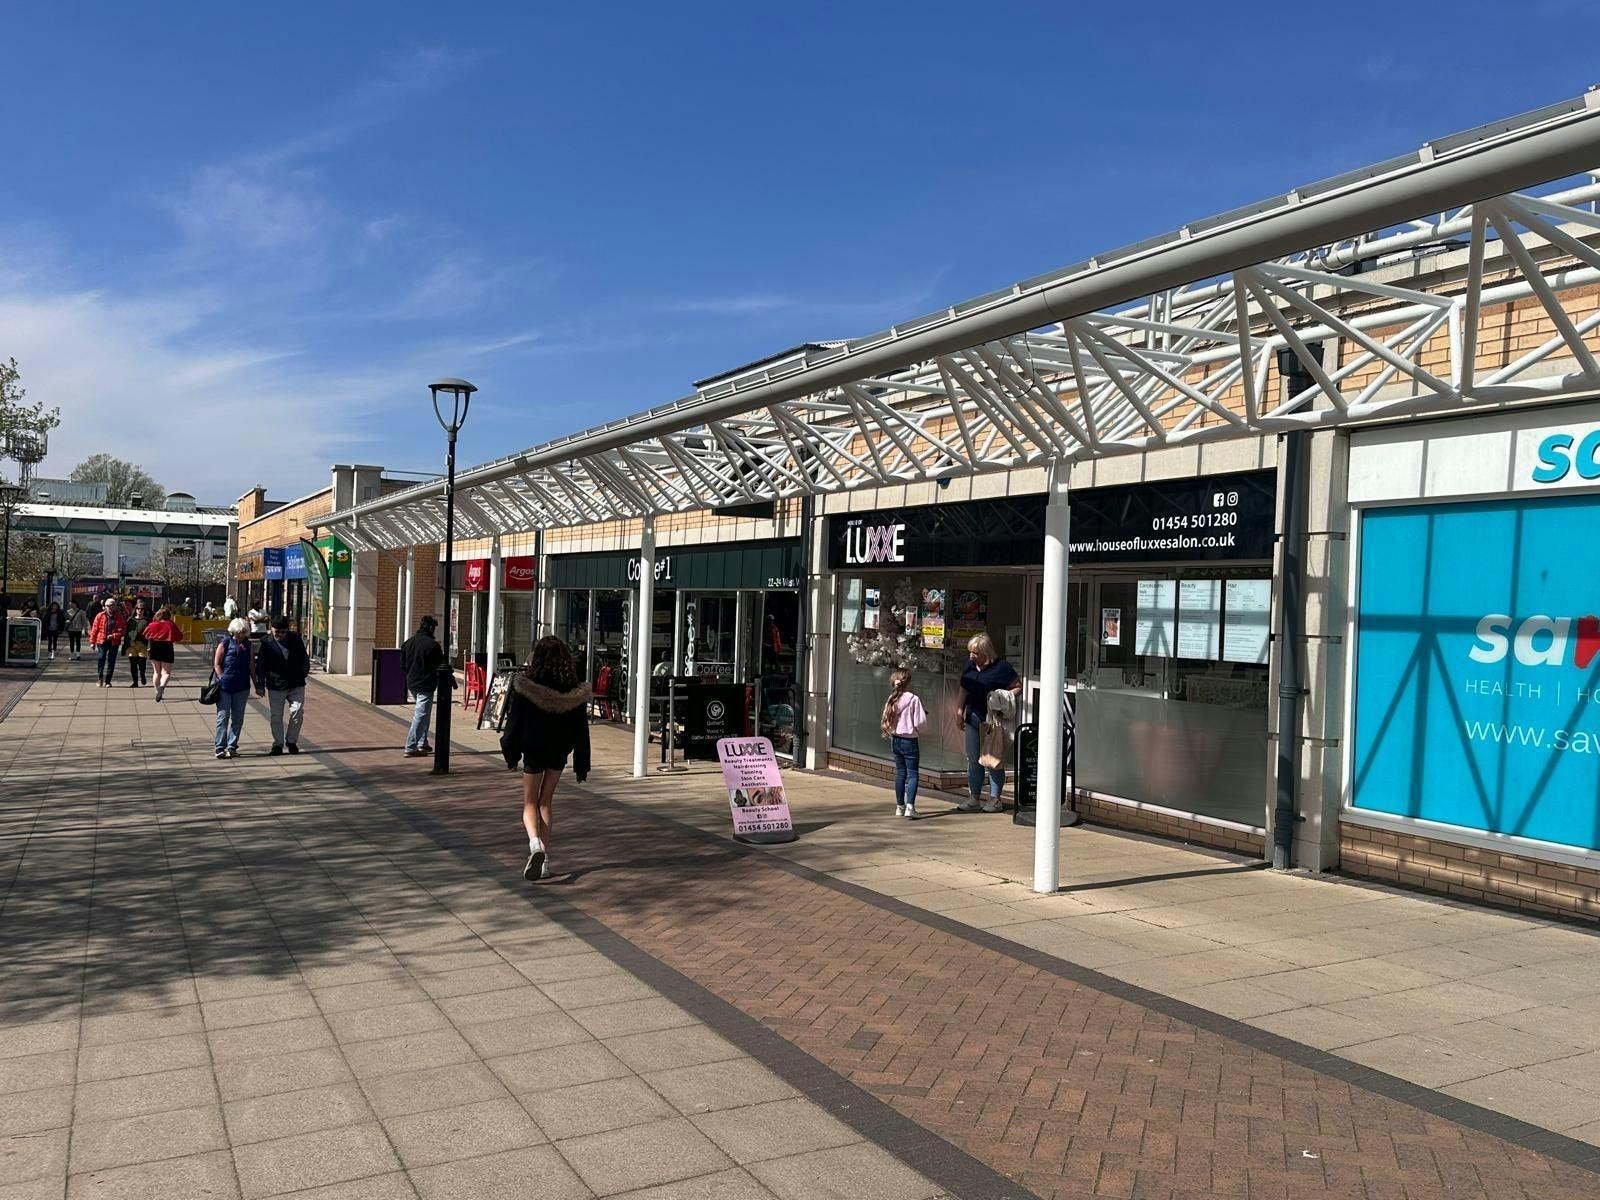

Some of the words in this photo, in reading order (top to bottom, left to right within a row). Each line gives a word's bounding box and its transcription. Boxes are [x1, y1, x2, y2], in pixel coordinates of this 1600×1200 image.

[1153, 516, 1188, 530] 01454
[1191, 512, 1238, 528] 501280
[846, 524, 906, 563] LUXXE
[1069, 532, 1236, 553] www.houseofluxxesalon.co.uk
[468, 564, 481, 581] Argos
[509, 566, 535, 577] Argos
[628, 556, 671, 580] Coe#1
[1465, 679, 1541, 699] HEALTH
[725, 743, 767, 756] LUXXE
[738, 824, 761, 832] 01454
[763, 822, 789, 830] 501280
